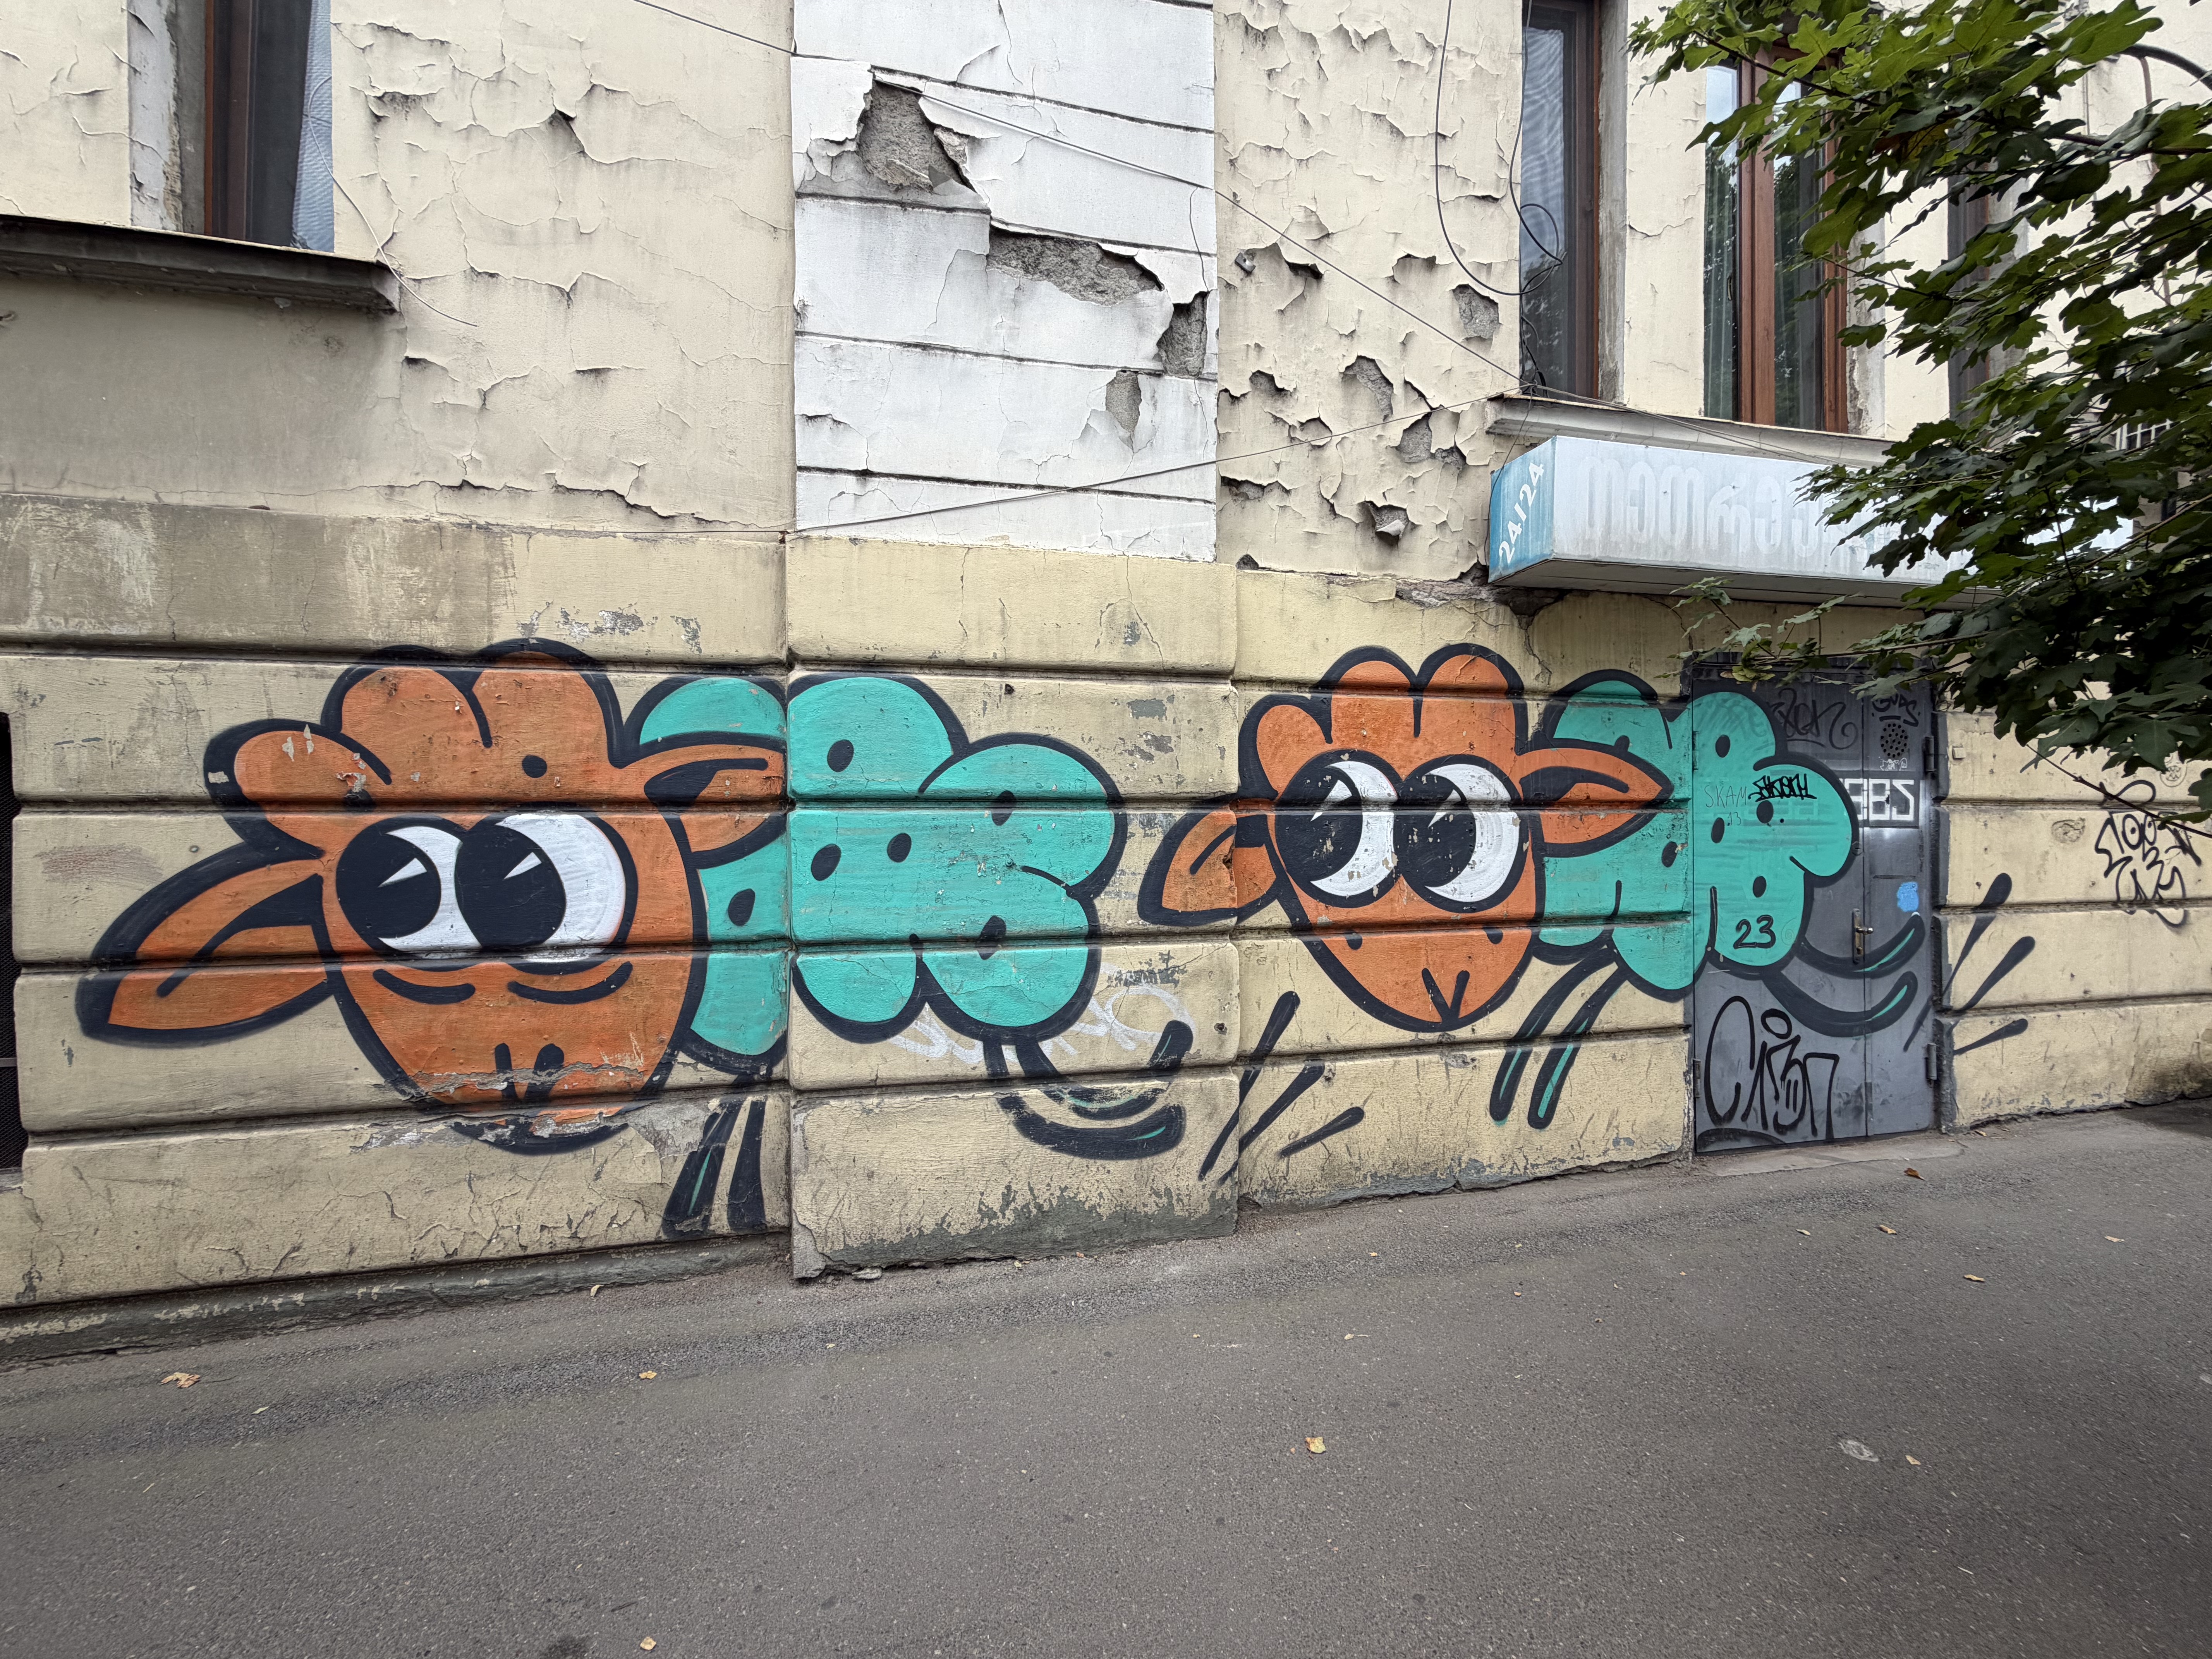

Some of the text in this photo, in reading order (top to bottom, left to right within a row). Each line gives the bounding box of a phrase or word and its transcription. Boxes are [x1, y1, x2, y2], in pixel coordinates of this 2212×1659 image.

[1499, 462, 1544, 564] 24/24
[1704, 785, 1747, 808] SKAM
[1733, 914, 1776, 949] 23
